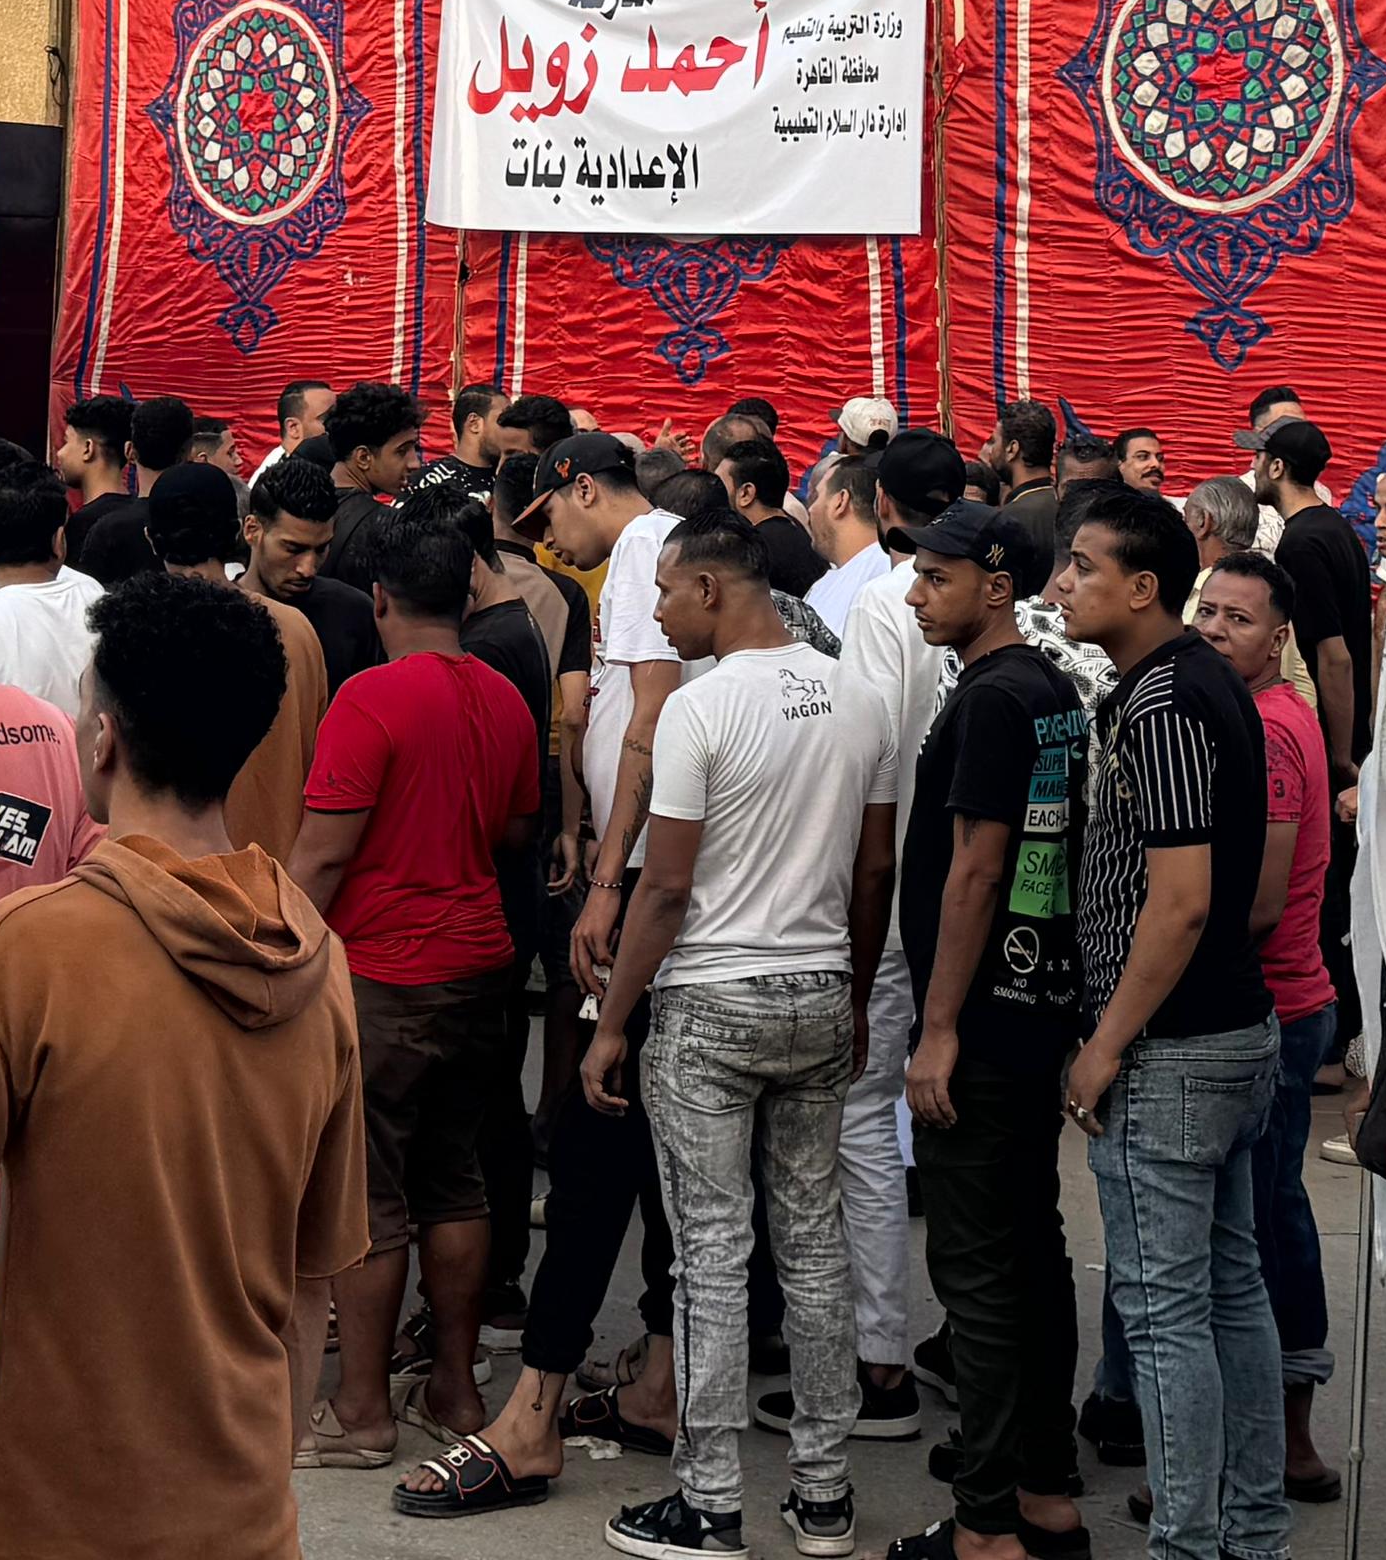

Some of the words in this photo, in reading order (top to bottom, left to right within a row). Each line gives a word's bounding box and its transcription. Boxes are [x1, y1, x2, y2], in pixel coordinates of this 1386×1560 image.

[781, 17, 825, 47] والتعليم
[827, 14, 869, 42] التربية
[873, 11, 903, 39] وزارة
[467, 15, 599, 124] زويل
[796, 57, 838, 93] القاهرة
[840, 55, 879, 84] محافظة
[772, 105, 823, 142] التعليمية
[826, 108, 857, 142] السلام
[857, 108, 876, 140] دار
[878, 104, 907, 142] إدارة
[505, 136, 567, 204] بنات
[574, 136, 699, 206] الإعدادية
[781, 700, 832, 721] YAGON
[3, 833, 37, 860] AM
[992, 985, 1037, 1005] SMOKING
[1012, 977, 1028, 989] NO
